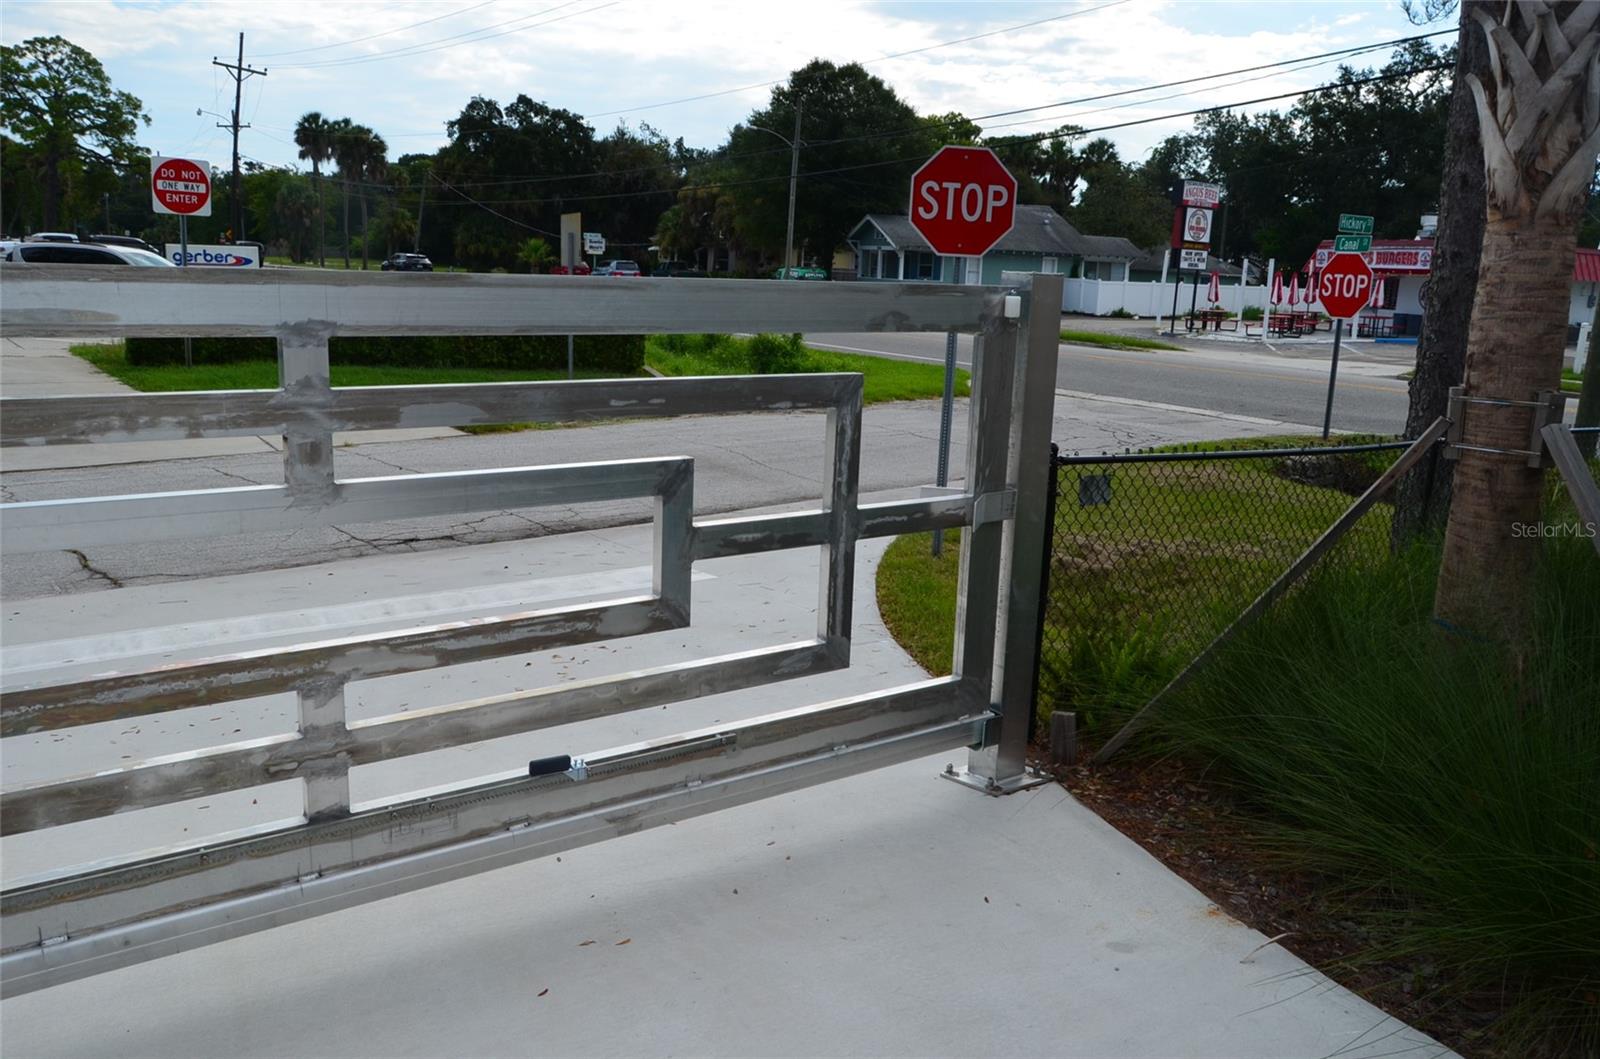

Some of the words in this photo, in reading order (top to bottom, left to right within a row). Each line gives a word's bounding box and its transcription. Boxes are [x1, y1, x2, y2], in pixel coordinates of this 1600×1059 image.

[161, 168, 175, 178] DO
[182, 171, 200, 180] NOT
[162, 181, 178, 190] ONE
[183, 183, 201, 192] WAY
[166, 193, 198, 204] ENTER
[918, 180, 1009, 223] STOP
[1341, 216, 1367, 232] Hickory
[1340, 238, 1360, 250] Canal
[172, 249, 232, 266] gerber
[1375, 251, 1420, 266] BURGERS
[1321, 273, 1368, 298] STOP
